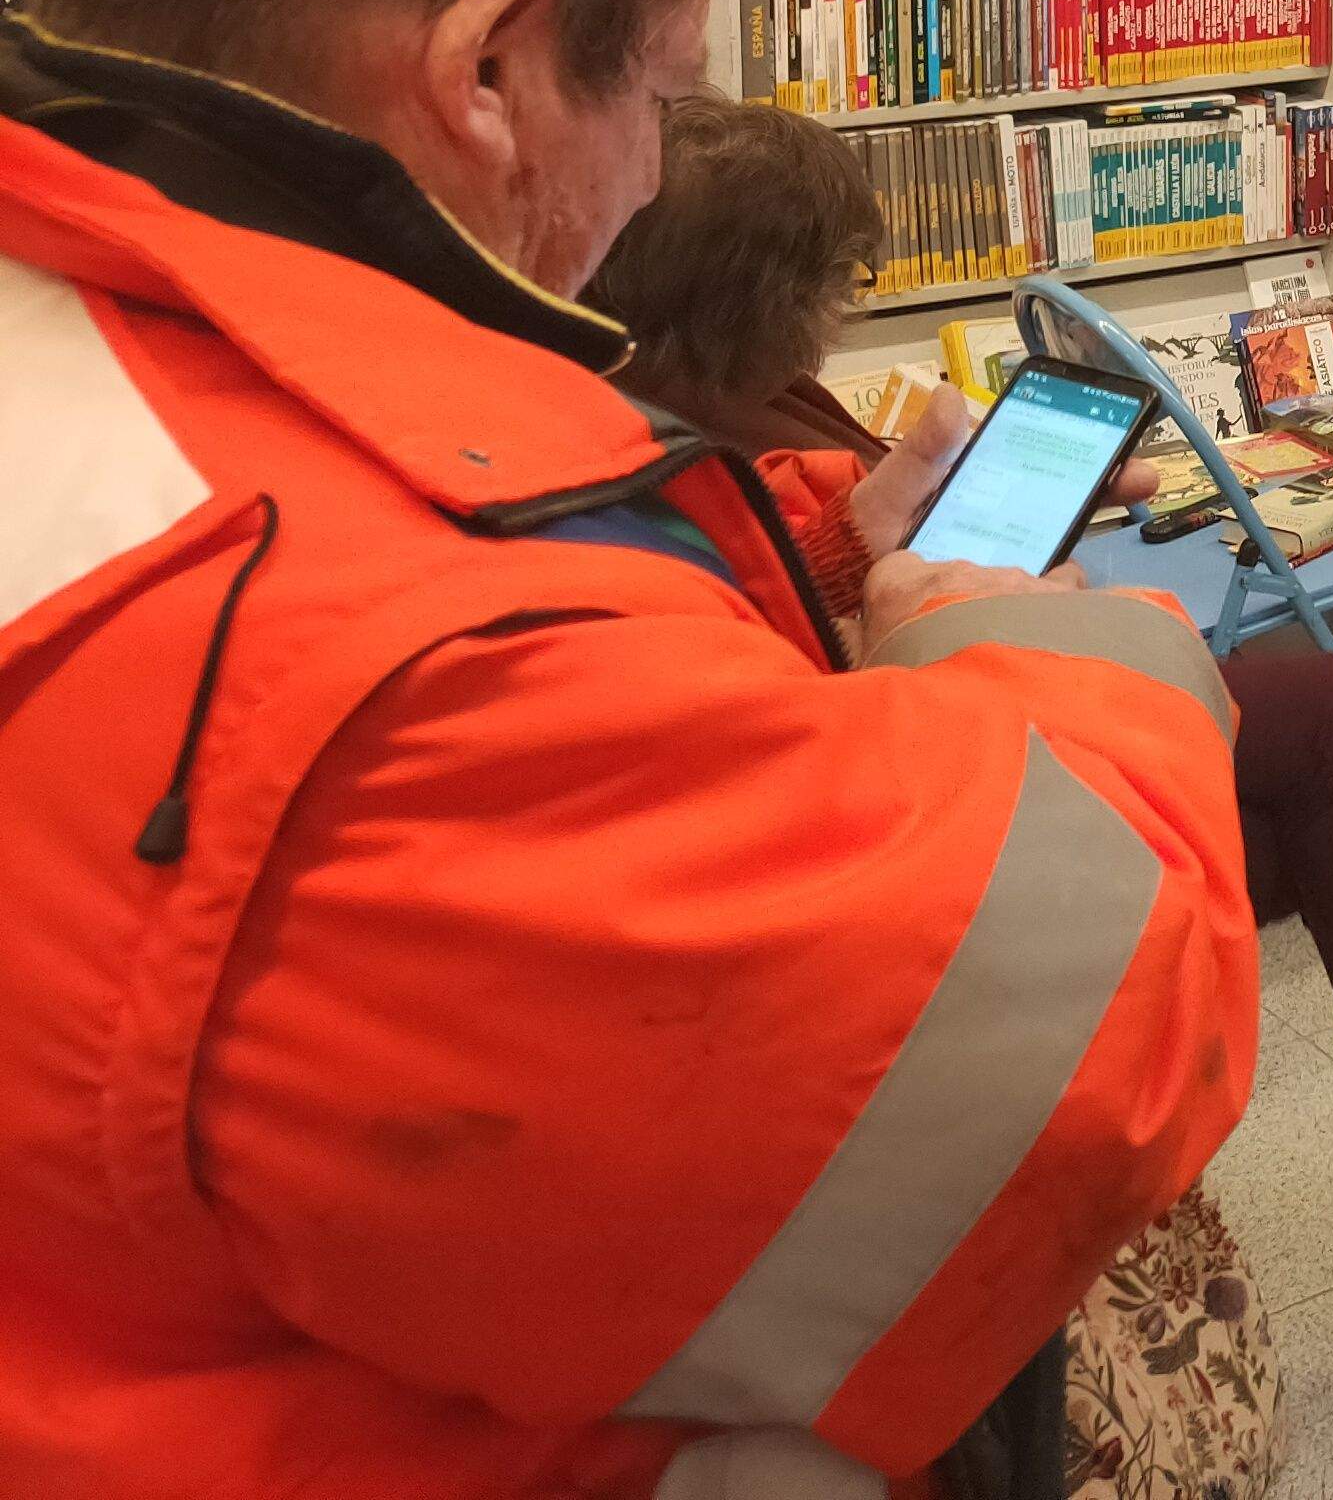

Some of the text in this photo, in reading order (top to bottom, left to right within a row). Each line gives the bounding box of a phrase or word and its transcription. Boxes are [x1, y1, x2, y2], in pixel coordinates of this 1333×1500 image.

[752, 5, 764, 59] ESPAÑA
[1006, 155, 1014, 186] MOTO
[1273, 309, 1287, 320] 12
[1311, 338, 1333, 387] ASIÁTICO
